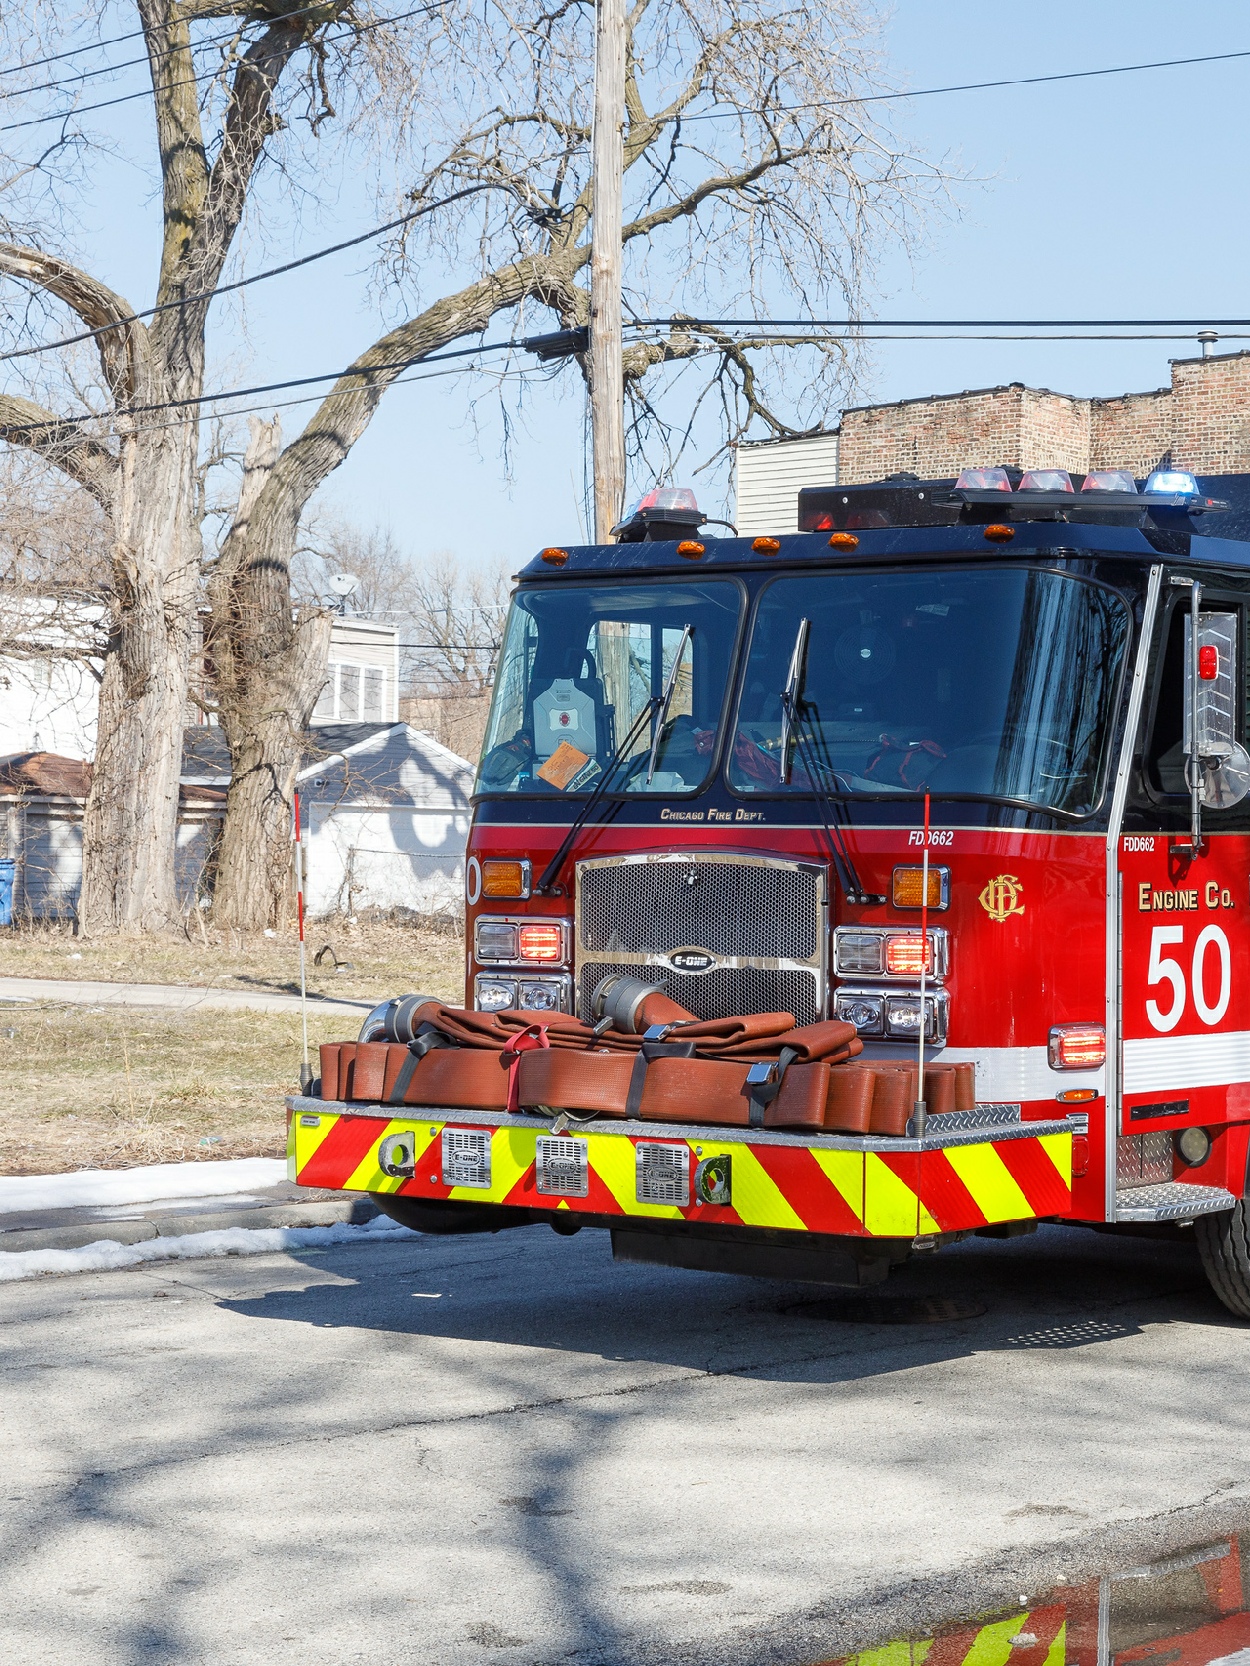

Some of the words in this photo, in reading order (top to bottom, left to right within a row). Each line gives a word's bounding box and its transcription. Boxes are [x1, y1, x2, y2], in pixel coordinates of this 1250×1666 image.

[1123, 836, 1155, 852] FDD662
[1138, 881, 1199, 912] ENGINE
[675, 955, 708, 966] E-ONE
[1145, 923, 1231, 1033] 50
[454, 1154, 479, 1163] E-ONE
[549, 1160, 575, 1171] E-ONE
